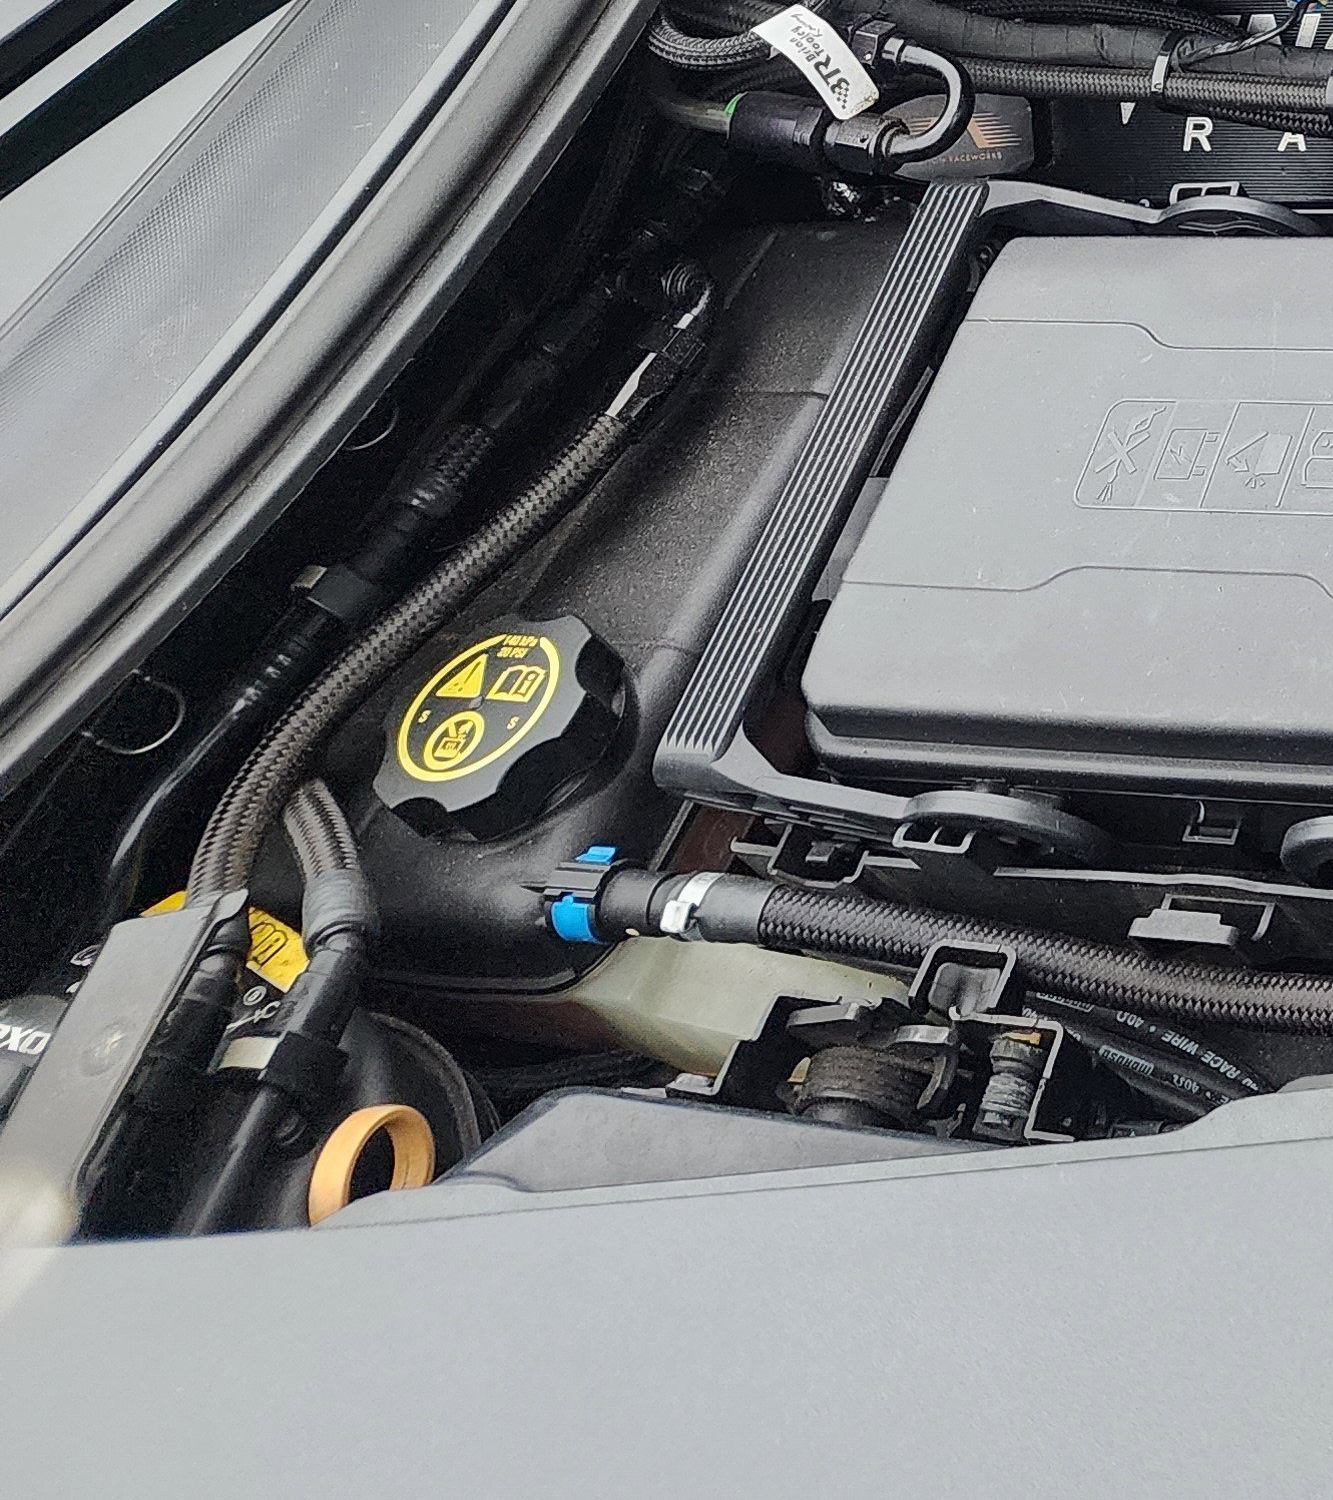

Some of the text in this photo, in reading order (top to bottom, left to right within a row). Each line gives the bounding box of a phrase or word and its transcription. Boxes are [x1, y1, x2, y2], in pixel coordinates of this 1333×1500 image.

[789, 37, 817, 62] Brian
[1161, 1029, 1200, 1056] WIRE
[1200, 1050, 1242, 1080] RACE
